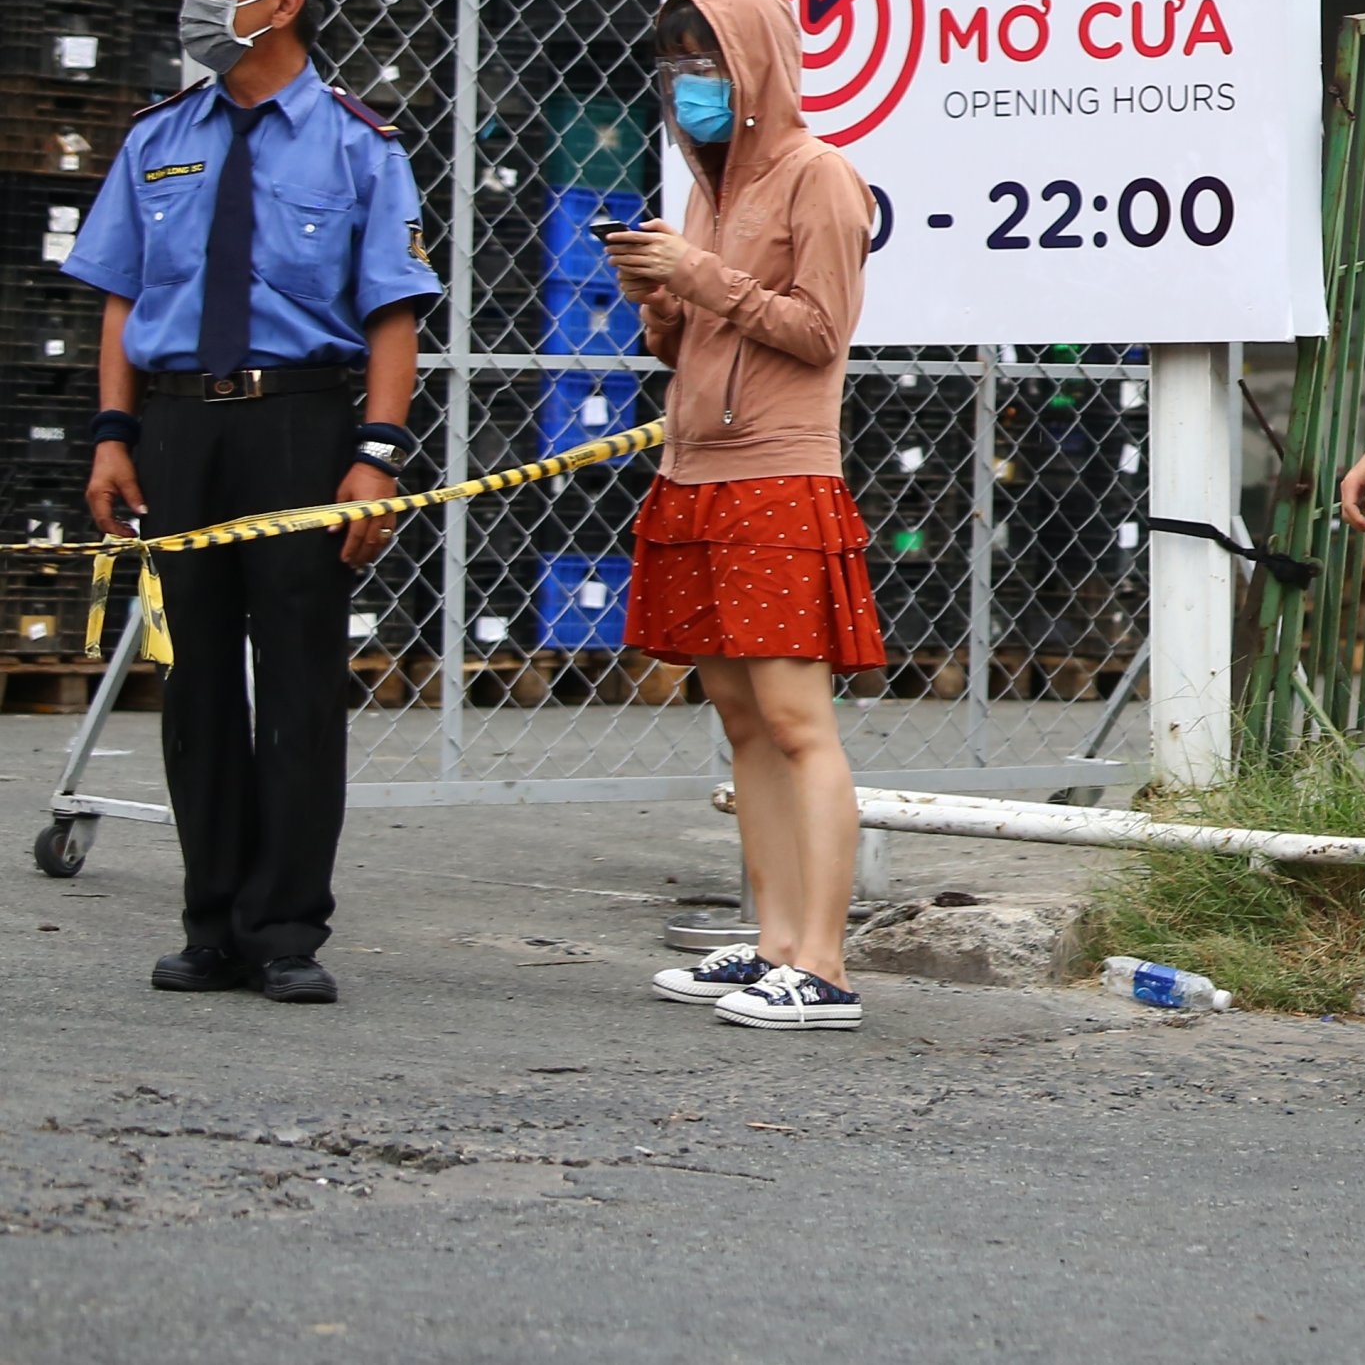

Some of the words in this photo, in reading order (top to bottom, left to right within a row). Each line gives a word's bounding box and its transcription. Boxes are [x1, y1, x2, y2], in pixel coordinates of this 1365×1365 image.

[944, 87, 1100, 119] OPENING
[1113, 83, 1236, 114] HOURS
[986, 175, 1235, 251] 22:00
